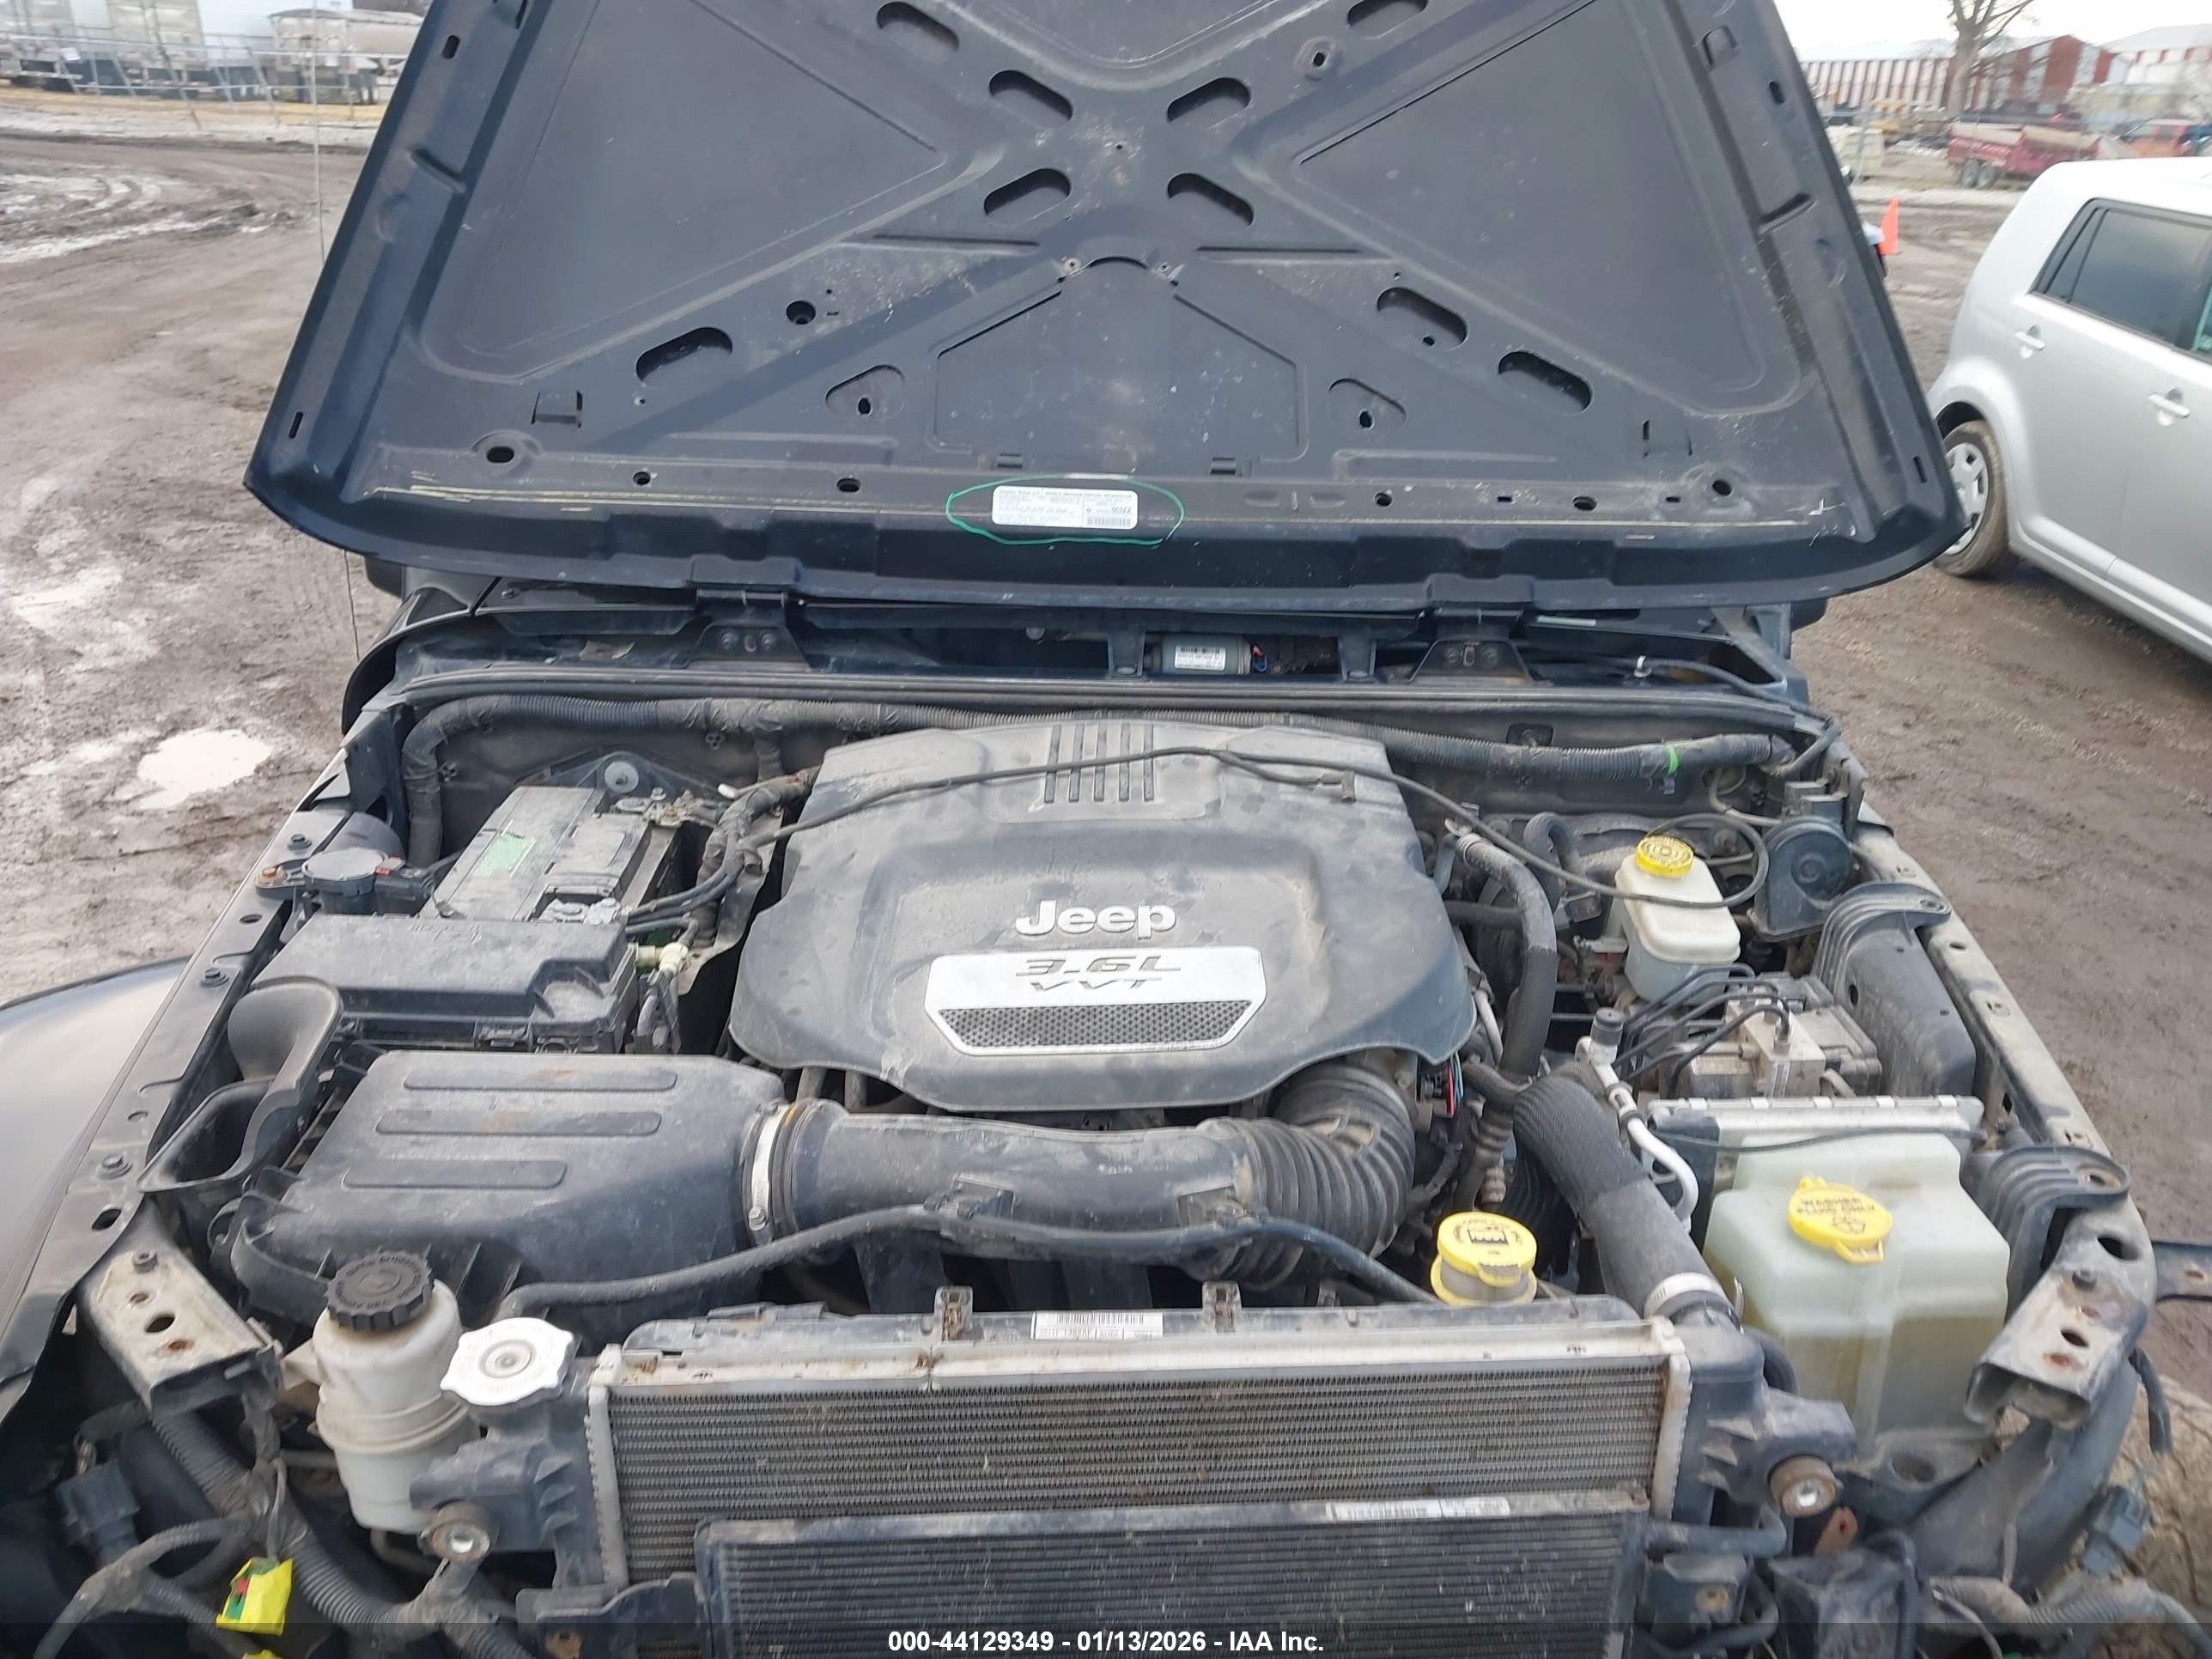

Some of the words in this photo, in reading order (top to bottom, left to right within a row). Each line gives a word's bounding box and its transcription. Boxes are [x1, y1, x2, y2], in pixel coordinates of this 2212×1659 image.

[1015, 899, 1176, 940] Jeep
[1015, 954, 1182, 976] 3.6L
[1030, 976, 1163, 992] VVT
